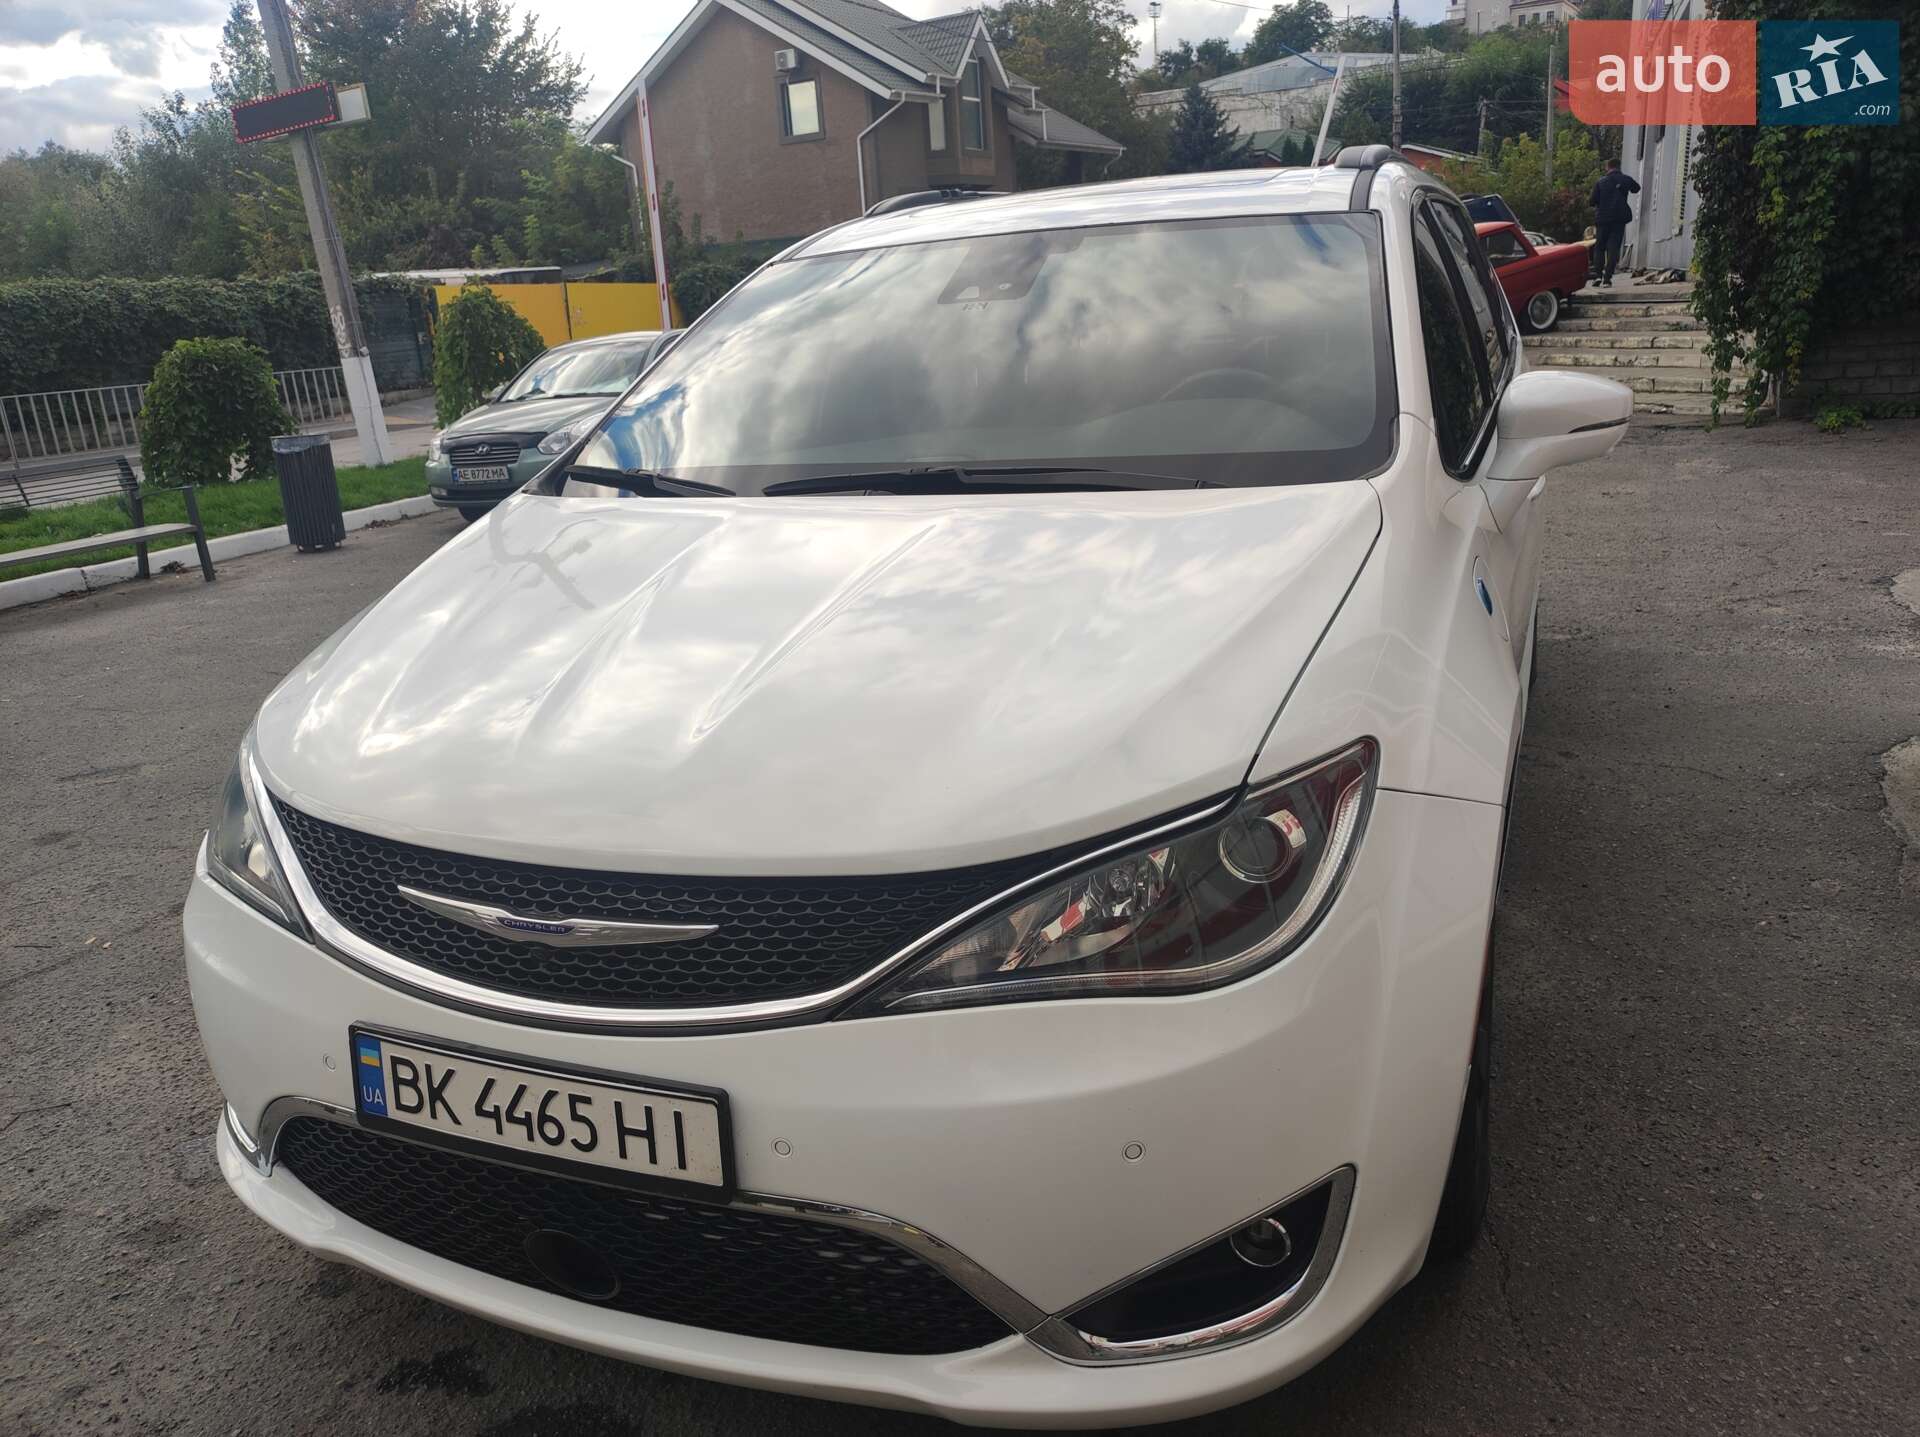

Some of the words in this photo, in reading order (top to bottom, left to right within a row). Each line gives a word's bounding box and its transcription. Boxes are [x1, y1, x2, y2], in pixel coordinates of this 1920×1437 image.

[458, 469, 471, 480] AE
[471, 468, 490, 480] 8772
[492, 467, 506, 478] MA
[503, 919, 566, 933] CHRYSLER
[362, 1085, 384, 1105] UA
[389, 1055, 462, 1125] BK
[474, 1077, 598, 1153] 4465
[614, 1100, 686, 1170] HI
